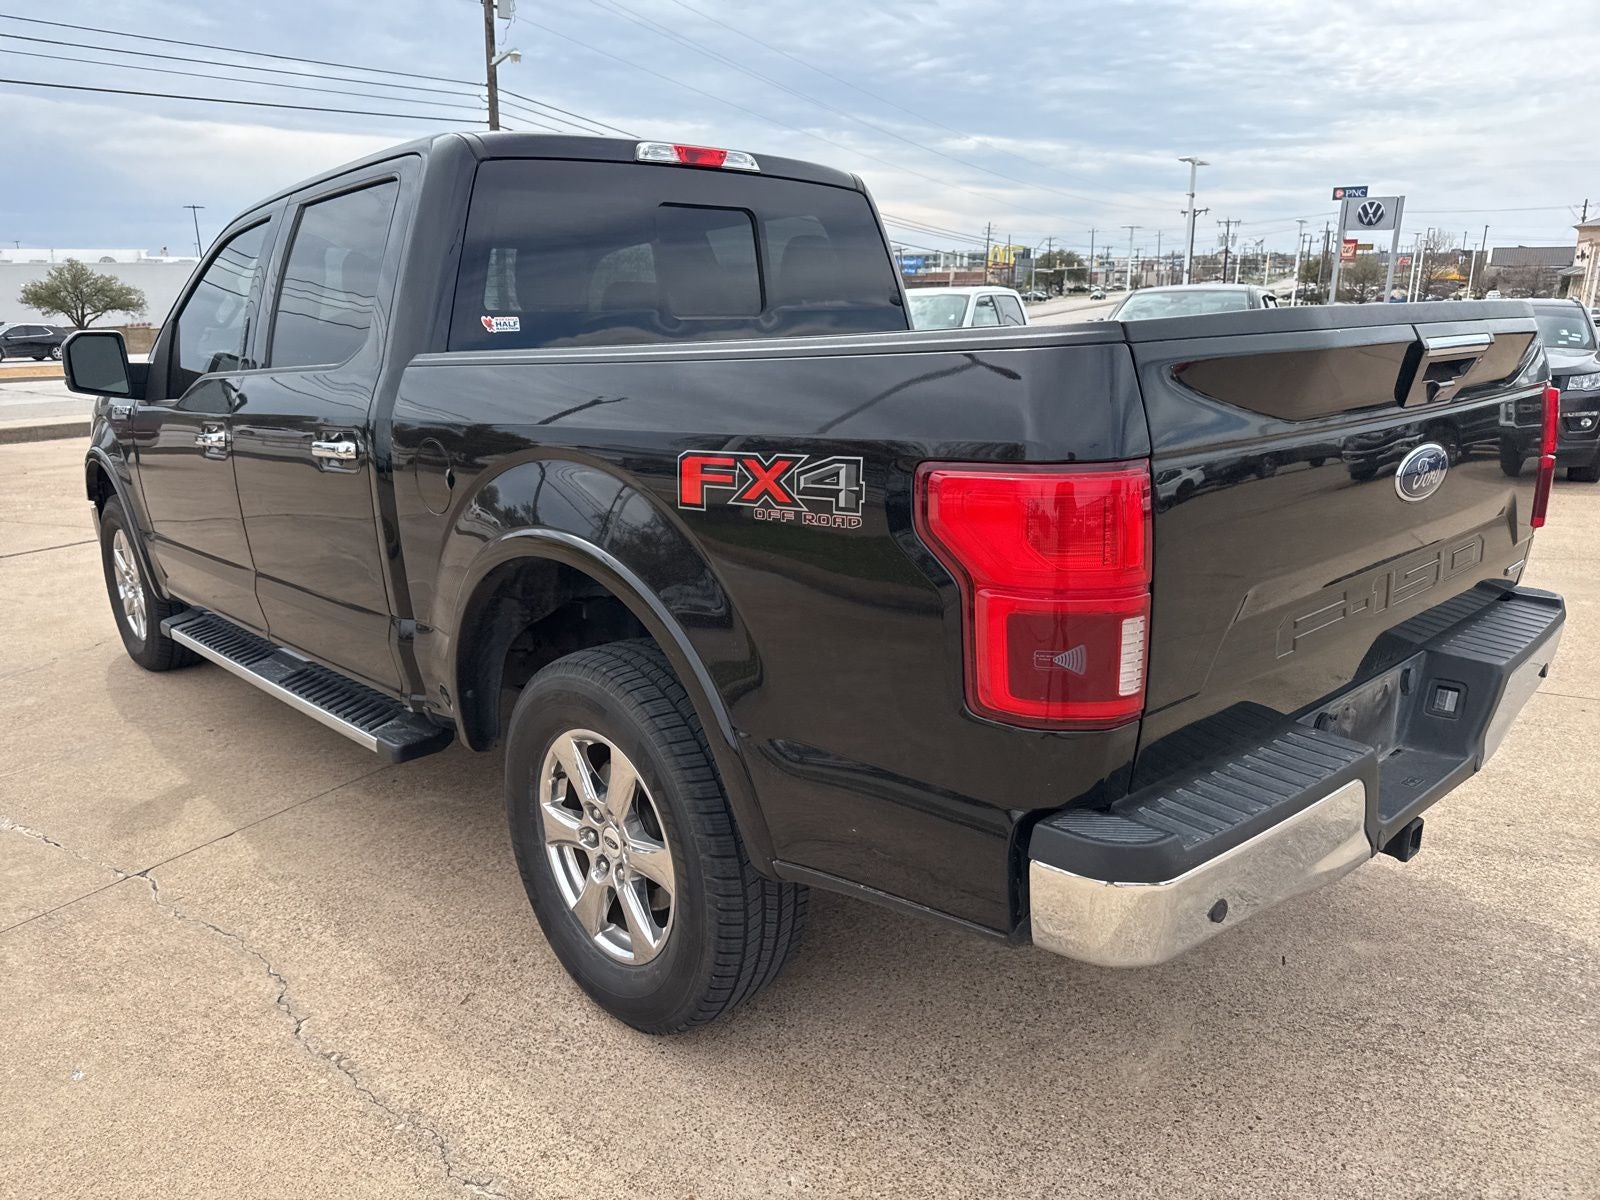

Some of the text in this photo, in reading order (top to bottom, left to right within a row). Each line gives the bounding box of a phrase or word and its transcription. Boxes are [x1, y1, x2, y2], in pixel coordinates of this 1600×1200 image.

[1345, 188, 1366, 197] PNC
[678, 450, 865, 515] FX4
[1412, 456, 1443, 491] Ford
[753, 507, 863, 530] OFF ROAD
